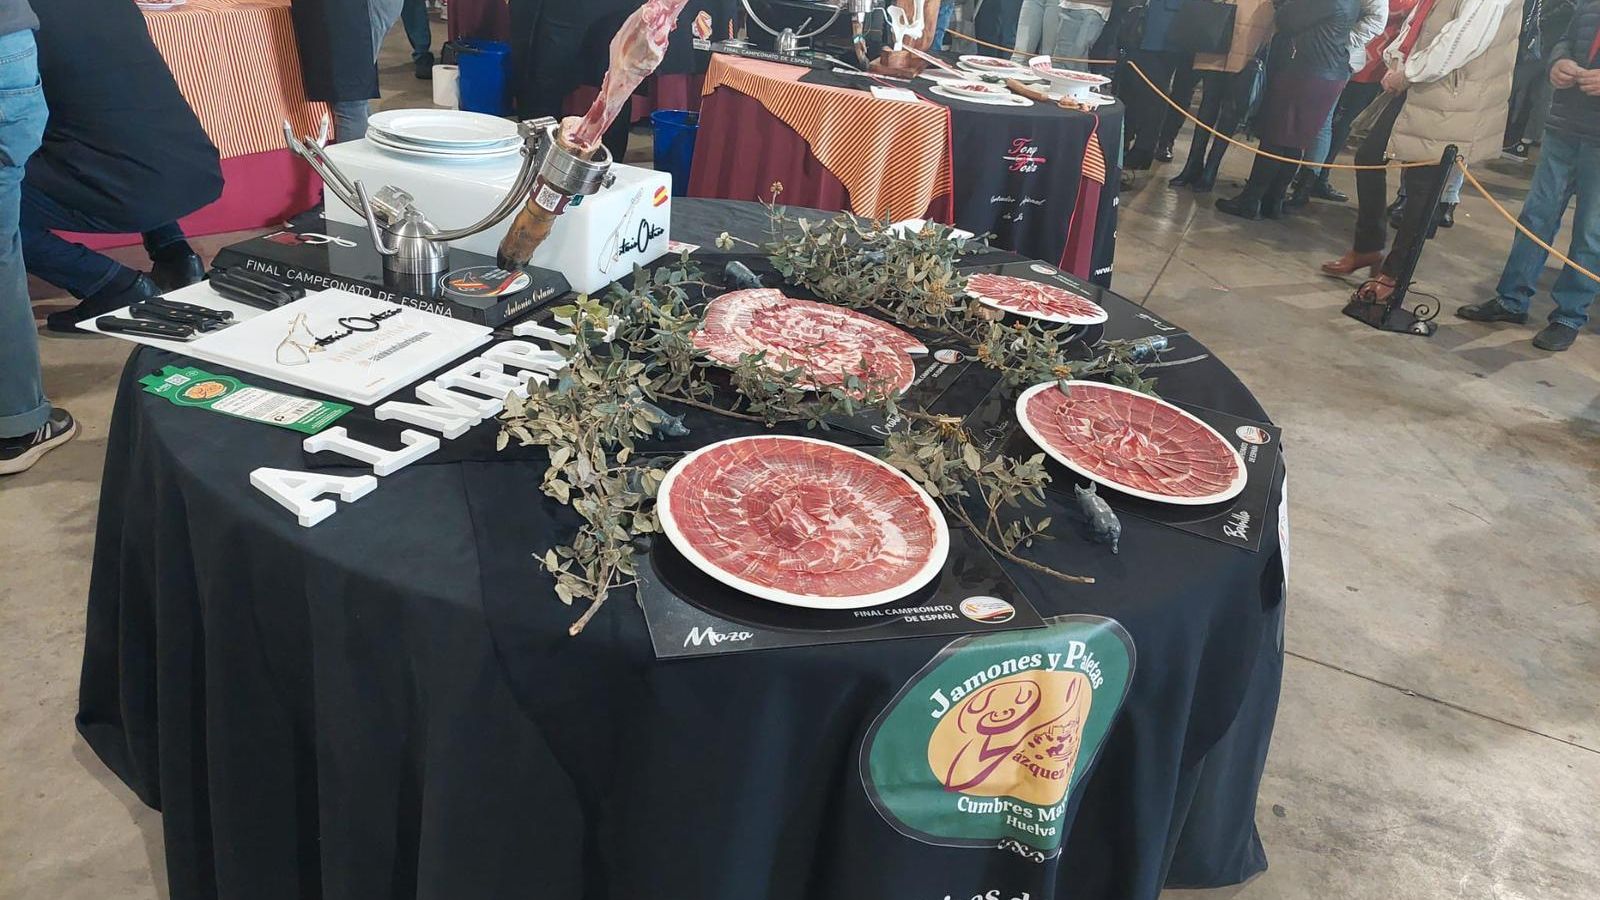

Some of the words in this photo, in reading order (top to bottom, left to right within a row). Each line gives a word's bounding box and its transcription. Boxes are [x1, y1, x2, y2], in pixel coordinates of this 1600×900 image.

[741, 49, 779, 60] CAMPEONATO
[790, 55, 812, 65] ESPAÑA
[1008, 138, 1038, 156] Tony
[246, 259, 281, 277] FINAL
[286, 269, 372, 297] CAMPEONATO
[377, 290, 396, 303] DE
[401, 296, 453, 318] ESPAÑA
[504, 299, 533, 318] Antonio
[854, 608, 884, 619] FINAL
[884, 604, 953, 617] CAMPEONATO
[904, 614, 920, 623] DE
[921, 611, 960, 622] ESPAÑA
[683, 626, 754, 648] Maza
[929, 653, 1042, 719] Jamones
[1045, 652, 1062, 673] y
[1063, 640, 1104, 690] Paletas
[957, 796, 1034, 819] Cumbres
[1038, 800, 1067, 822] May
[1006, 814, 1057, 837] Huelva
